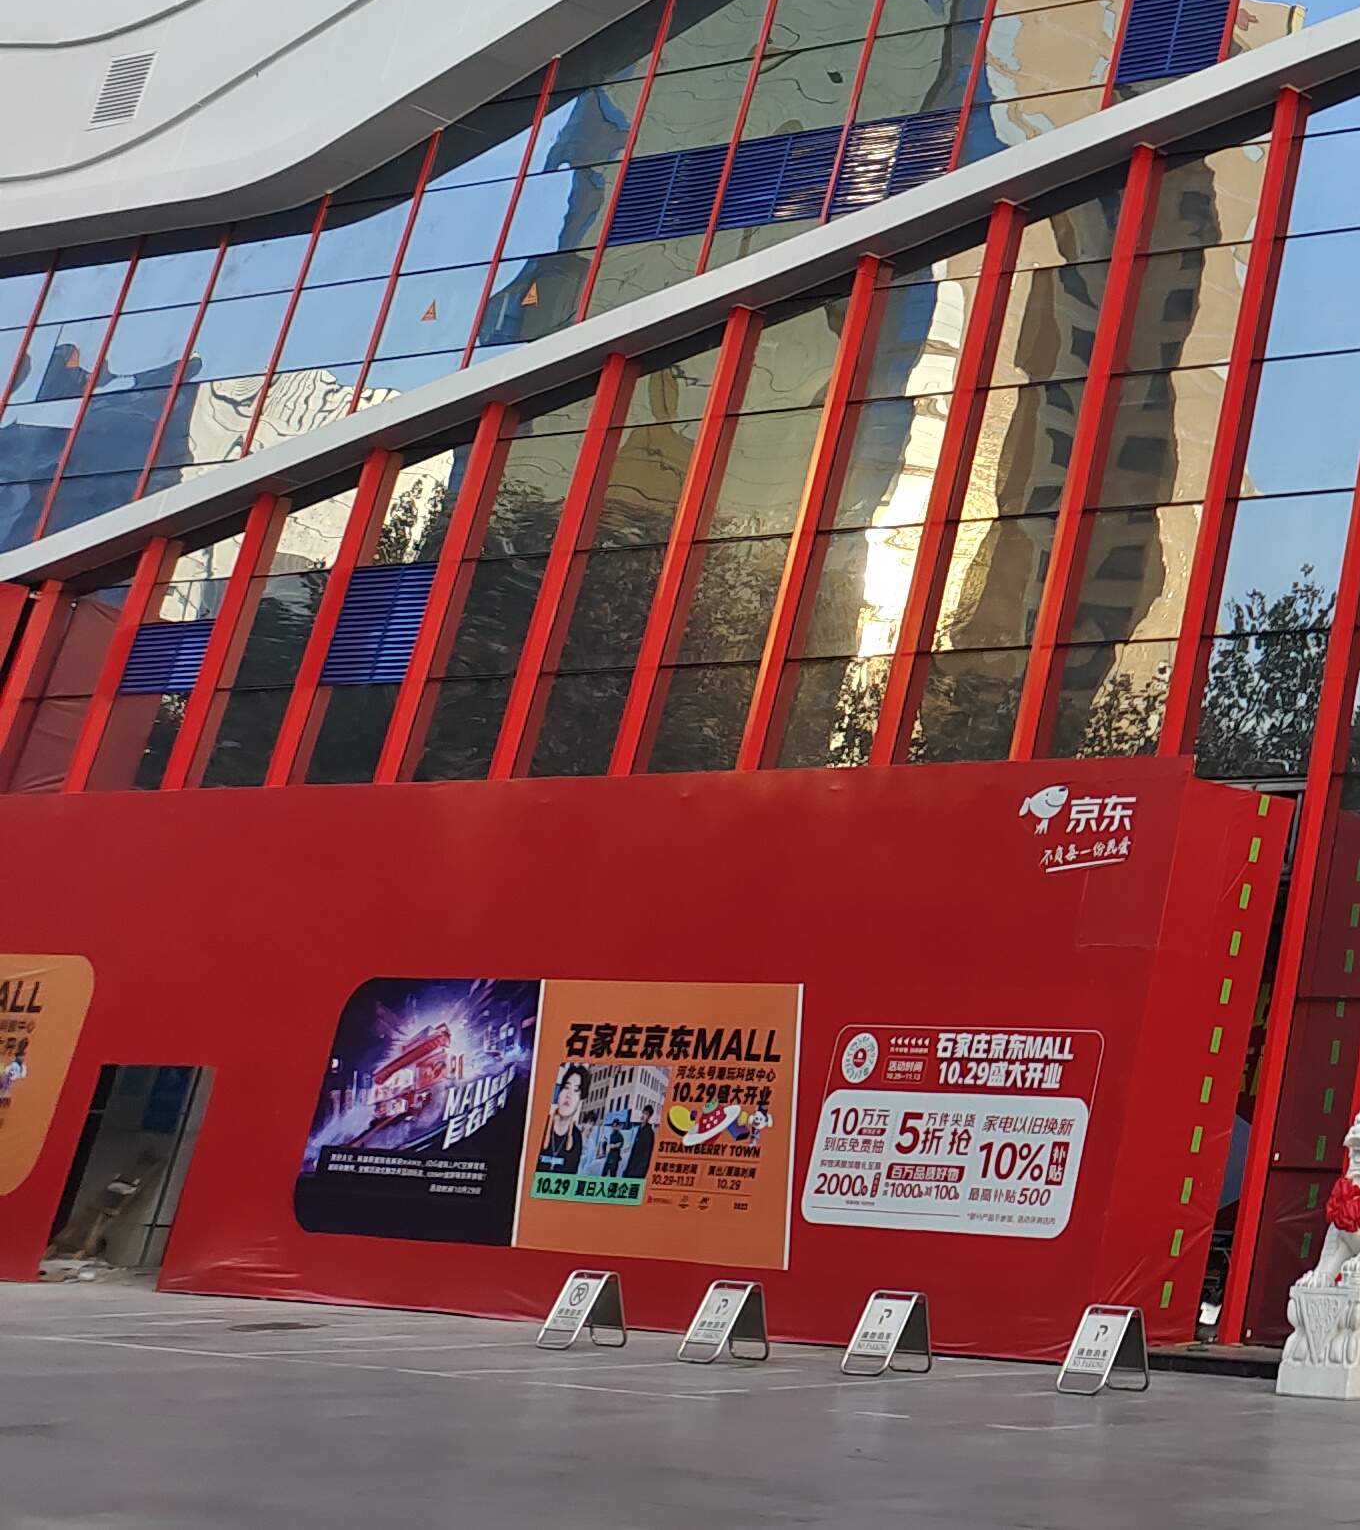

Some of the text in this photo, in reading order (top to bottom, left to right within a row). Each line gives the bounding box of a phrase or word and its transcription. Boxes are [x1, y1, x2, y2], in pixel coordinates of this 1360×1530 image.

[1065, 795, 1137, 834] 京东
[565, 1023, 782, 1063] 石家庄京东MALL
[936, 1032, 1075, 1061] 石家庄京东MALL
[939, 1061, 1064, 1090] 10.29盛大开业
[981, 1115, 1076, 1137] 家电以旧换新
[979, 1141, 1046, 1182] 10%
